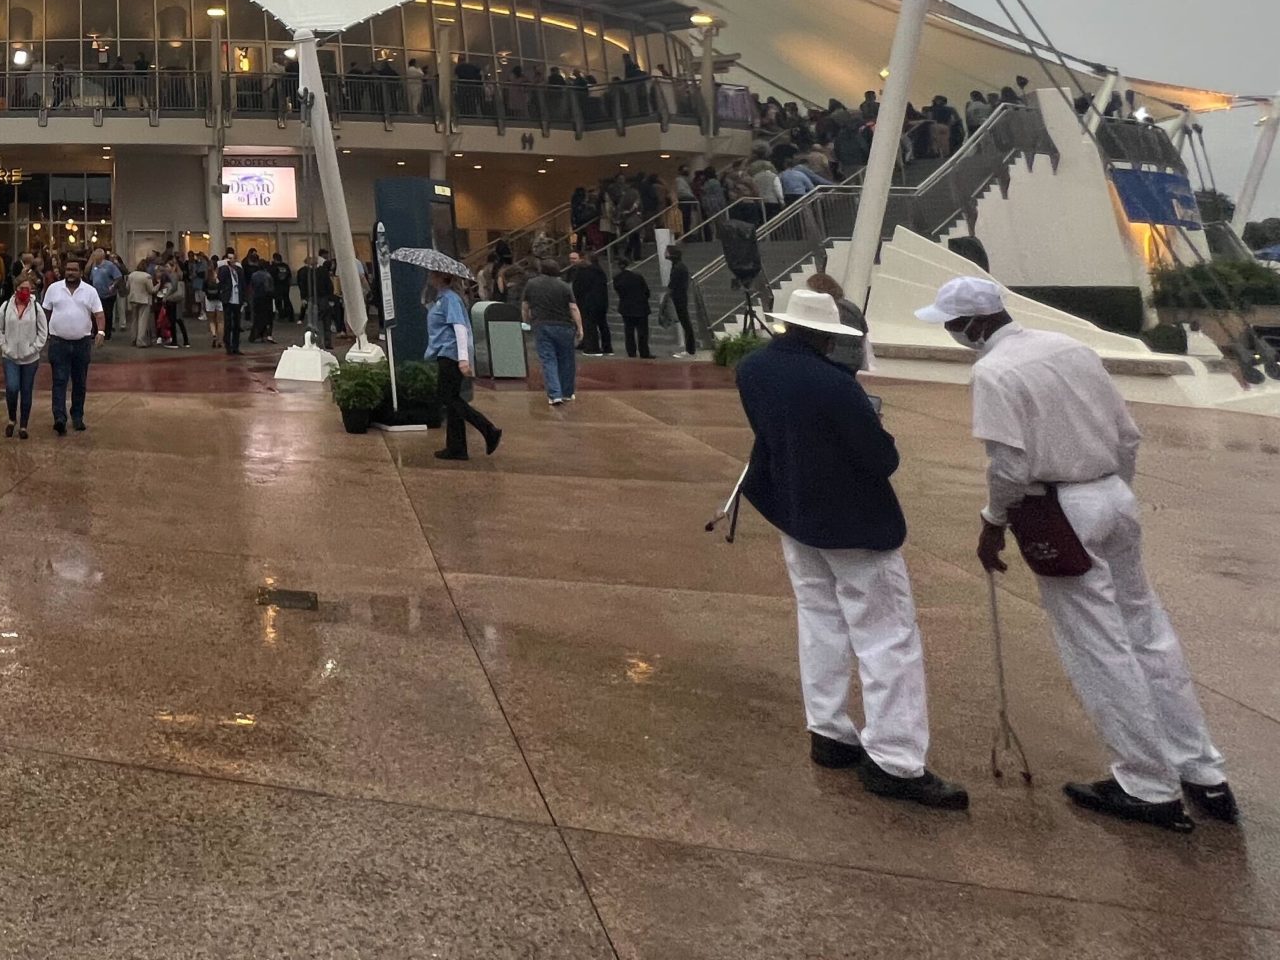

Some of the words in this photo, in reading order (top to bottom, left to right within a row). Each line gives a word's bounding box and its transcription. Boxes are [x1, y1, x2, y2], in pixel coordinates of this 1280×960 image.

[223, 158, 242, 167] BOX
[244, 158, 277, 167] OFFICE
[247, 193, 271, 206] Life
